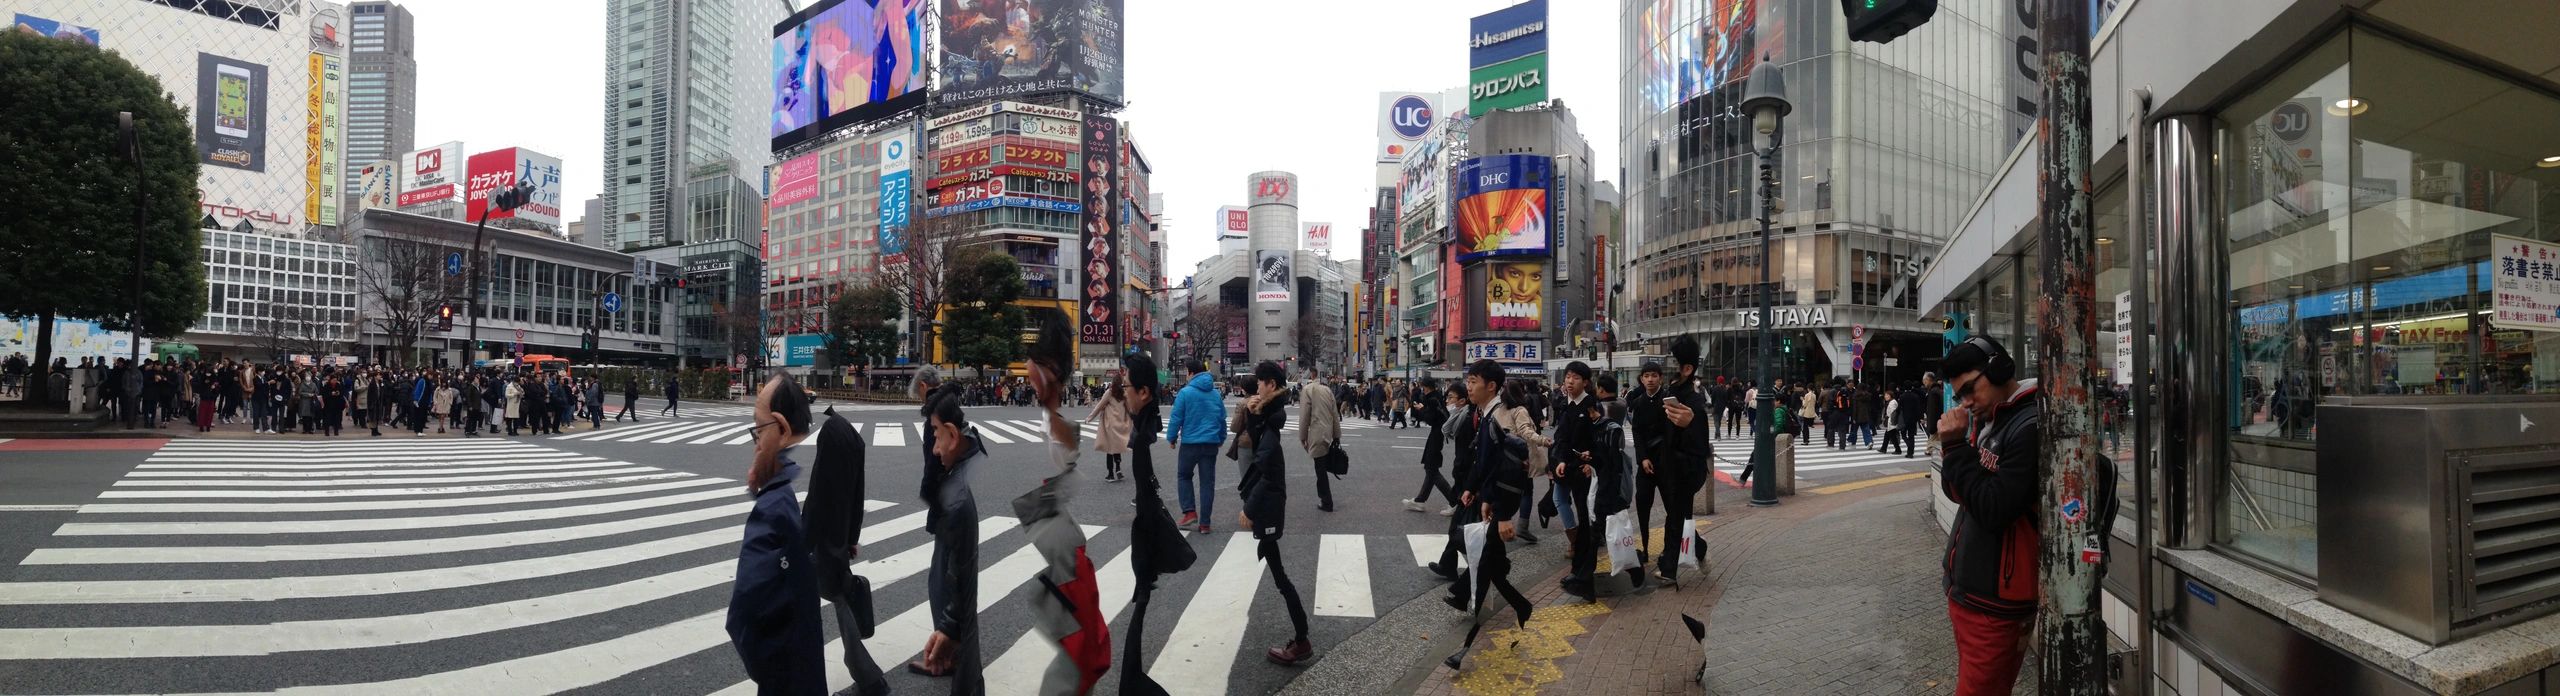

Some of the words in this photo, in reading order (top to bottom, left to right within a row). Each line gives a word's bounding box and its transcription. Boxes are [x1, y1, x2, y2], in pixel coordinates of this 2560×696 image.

[1079, 8, 1119, 31] MONSTER
[1082, 20, 1116, 39] HUNTER
[1469, 21, 1544, 48] Hisamitsu
[1472, 68, 1540, 100] サロンパス
[1087, 119, 1112, 131] EXO
[324, 91, 335, 198] 島根物産展
[929, 136, 939, 145] 9F
[211, 153, 240, 164] ROYALE
[217, 148, 239, 157] CLASH
[1006, 146, 1064, 163] コンタクト
[884, 161, 906, 170] eyecity
[941, 150, 990, 171] プライス
[470, 170, 513, 190] カラオケ
[519, 158, 561, 188] 大声
[969, 168, 994, 182] ガスト
[1047, 170, 1074, 183] ガスト
[1480, 172, 1508, 187] DHC
[955, 186, 986, 202] ガスト
[1257, 181, 1289, 202] 109
[928, 194, 939, 205] 7F
[883, 180, 896, 248] アイシティ
[1230, 221, 1247, 229] QLO
[1308, 225, 1329, 239] H&M
[683, 264, 708, 273] MARK
[712, 261, 734, 269] CITY
[1490, 302, 1538, 318] DMM
[1083, 324, 1114, 335] 01.31
[2400, 327, 2430, 344] TAX
[1468, 344, 1537, 359] 大盛堂書店
